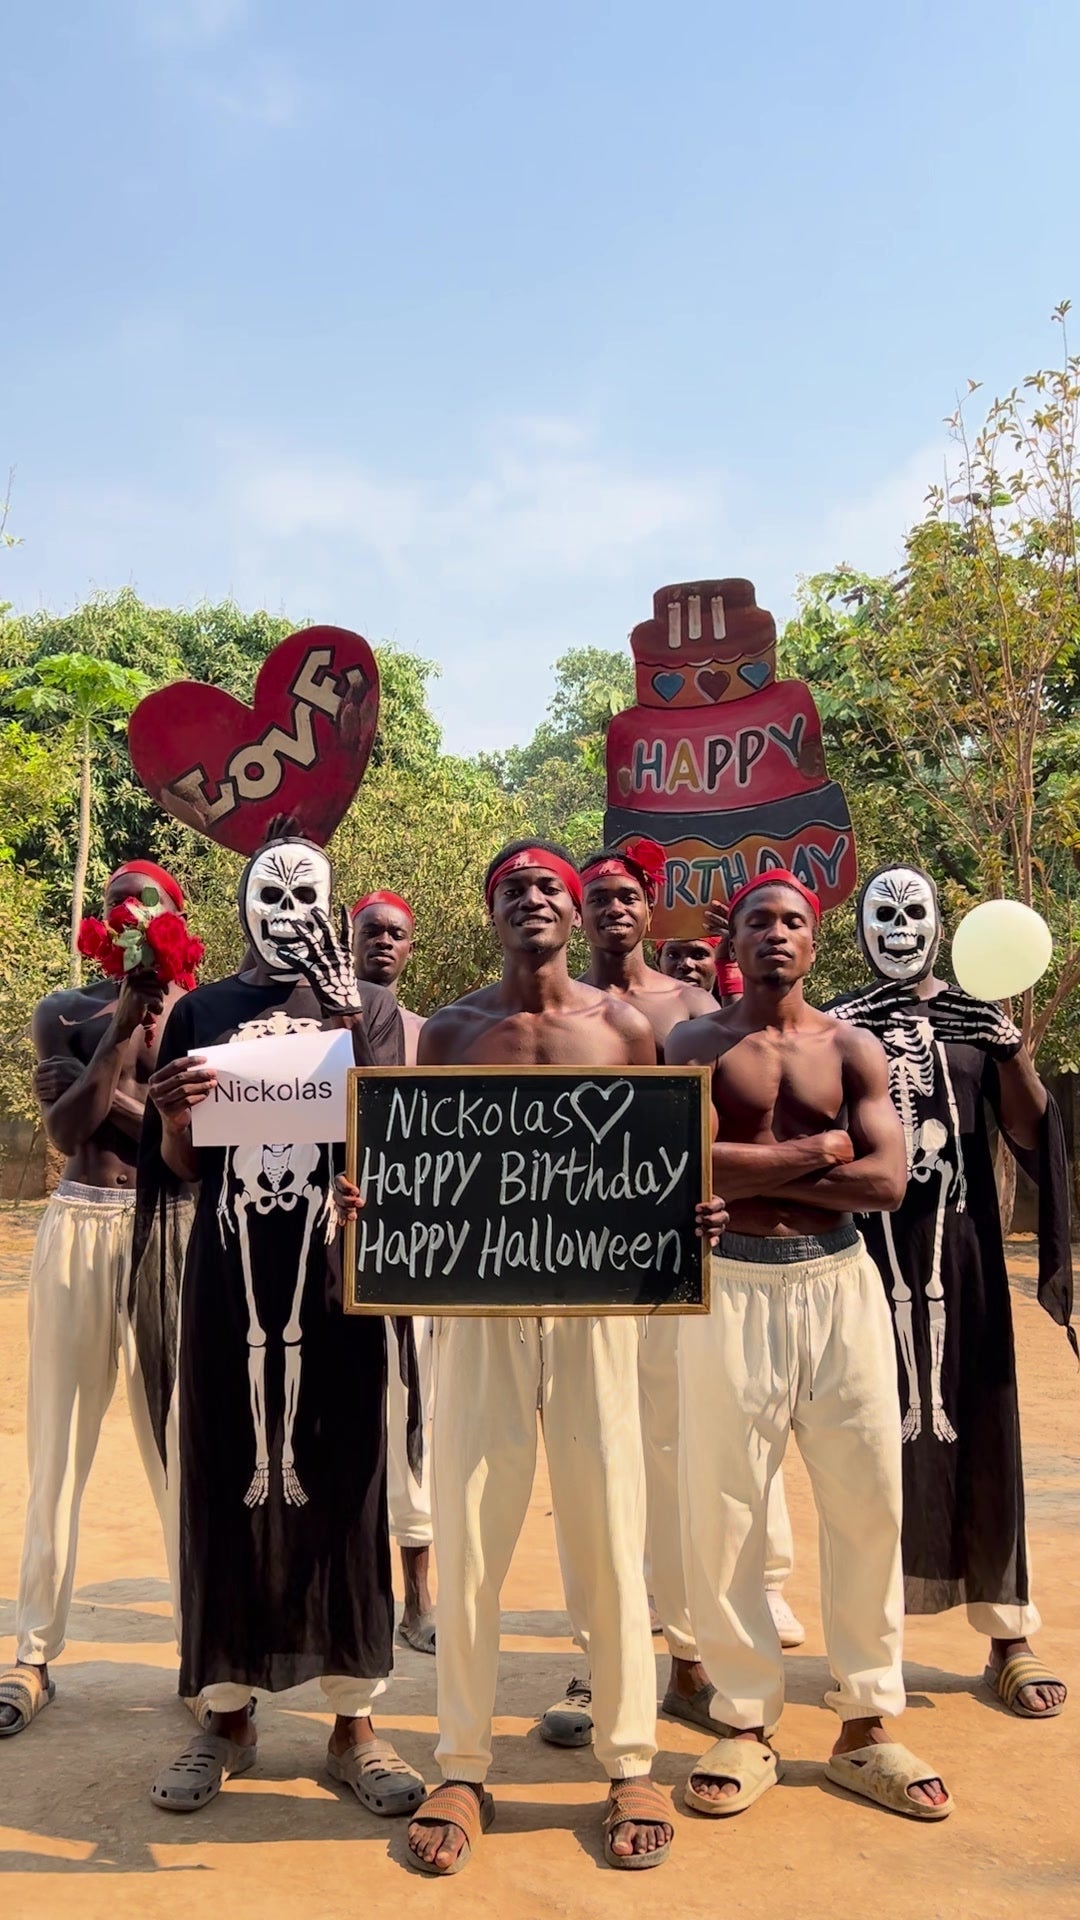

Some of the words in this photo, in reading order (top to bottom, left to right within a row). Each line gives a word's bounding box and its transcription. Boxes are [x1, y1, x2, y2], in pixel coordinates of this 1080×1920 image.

[172, 648, 368, 824] LOVE
[632, 714, 805, 793] HAPPY
[662, 834, 848, 909] RTHAY
[214, 1077, 333, 1102] Nickolas
[385, 1086, 574, 1142] Nickolas
[361, 1147, 482, 1206] Happy
[500, 1132, 689, 1206] Birthday
[358, 1218, 470, 1278] Happy
[478, 1214, 681, 1279] Halloween
